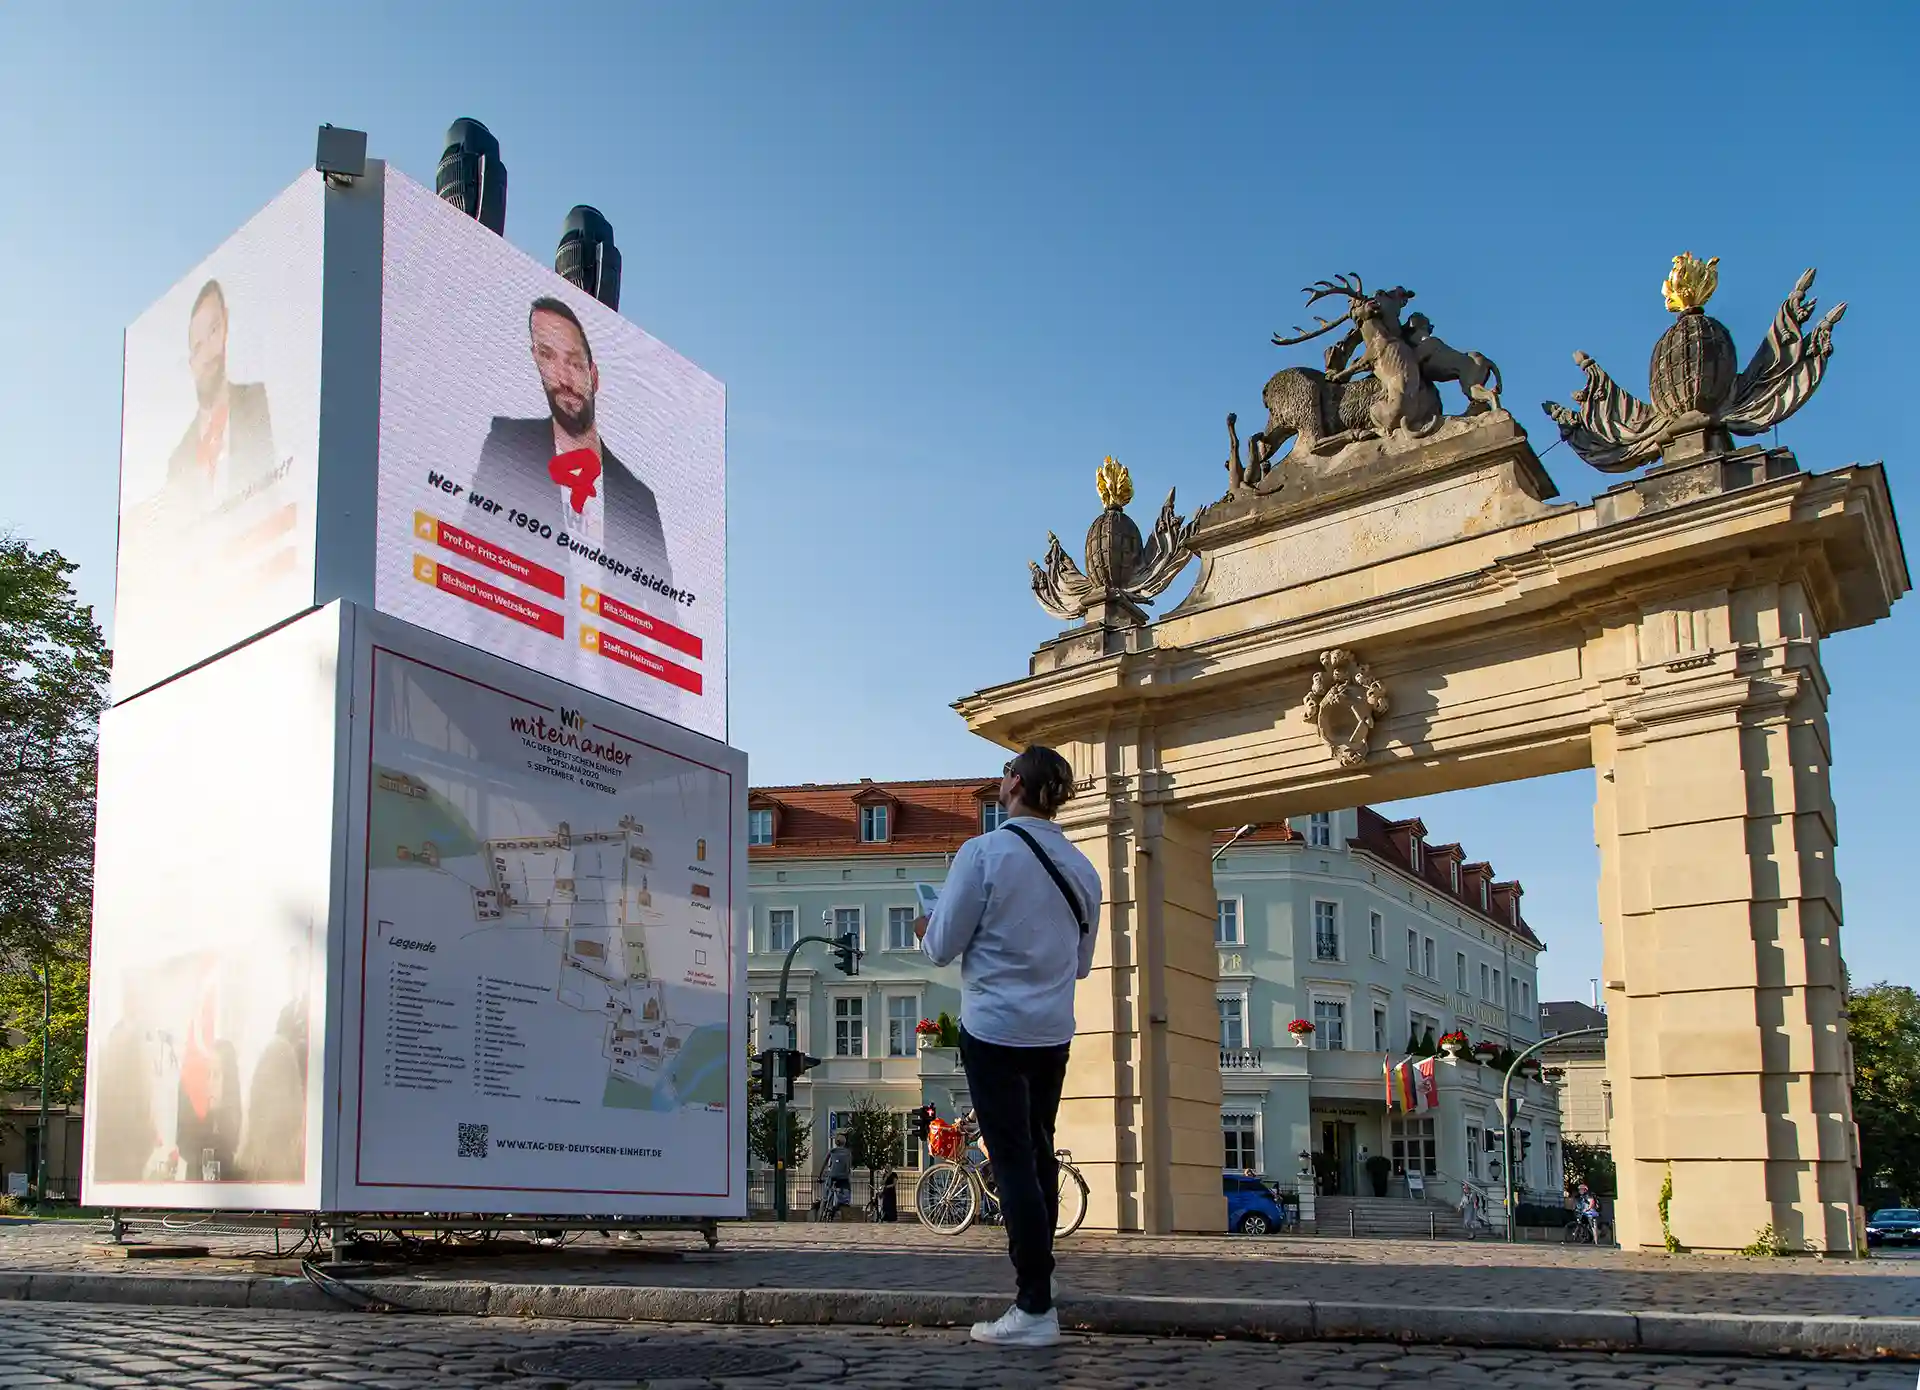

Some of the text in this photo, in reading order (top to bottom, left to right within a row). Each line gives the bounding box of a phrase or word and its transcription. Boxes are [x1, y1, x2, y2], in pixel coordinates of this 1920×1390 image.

[427, 470, 463, 496] Wer
[468, 491, 504, 515] war
[507, 508, 552, 539] 1990
[556, 531, 696, 607] Bundespräsident?
[442, 530, 464, 547] Prof.
[464, 540, 477, 553] Dr.
[478, 546, 497, 562] Fritz
[497, 555, 530, 576] Scherer
[442, 572, 476, 594] Richard
[477, 588, 493, 601] von
[603, 601, 618, 615] Rita
[603, 640, 664, 673] Steffen Heitmann
[560, 706, 588, 732] Wir
[509, 715, 633, 767] miteinander
[521, 737, 623, 777] TAG DER DEUTSCHEN EINHEIT
[546, 756, 600, 780] POTSDAM 2020
[585, 780, 618, 795] OKTOBER
[388, 936, 437, 953] Legende
[496, 1139, 662, 1158] WWW.TAG-DER-DEUTSCHEN-EINHEIT.DE
